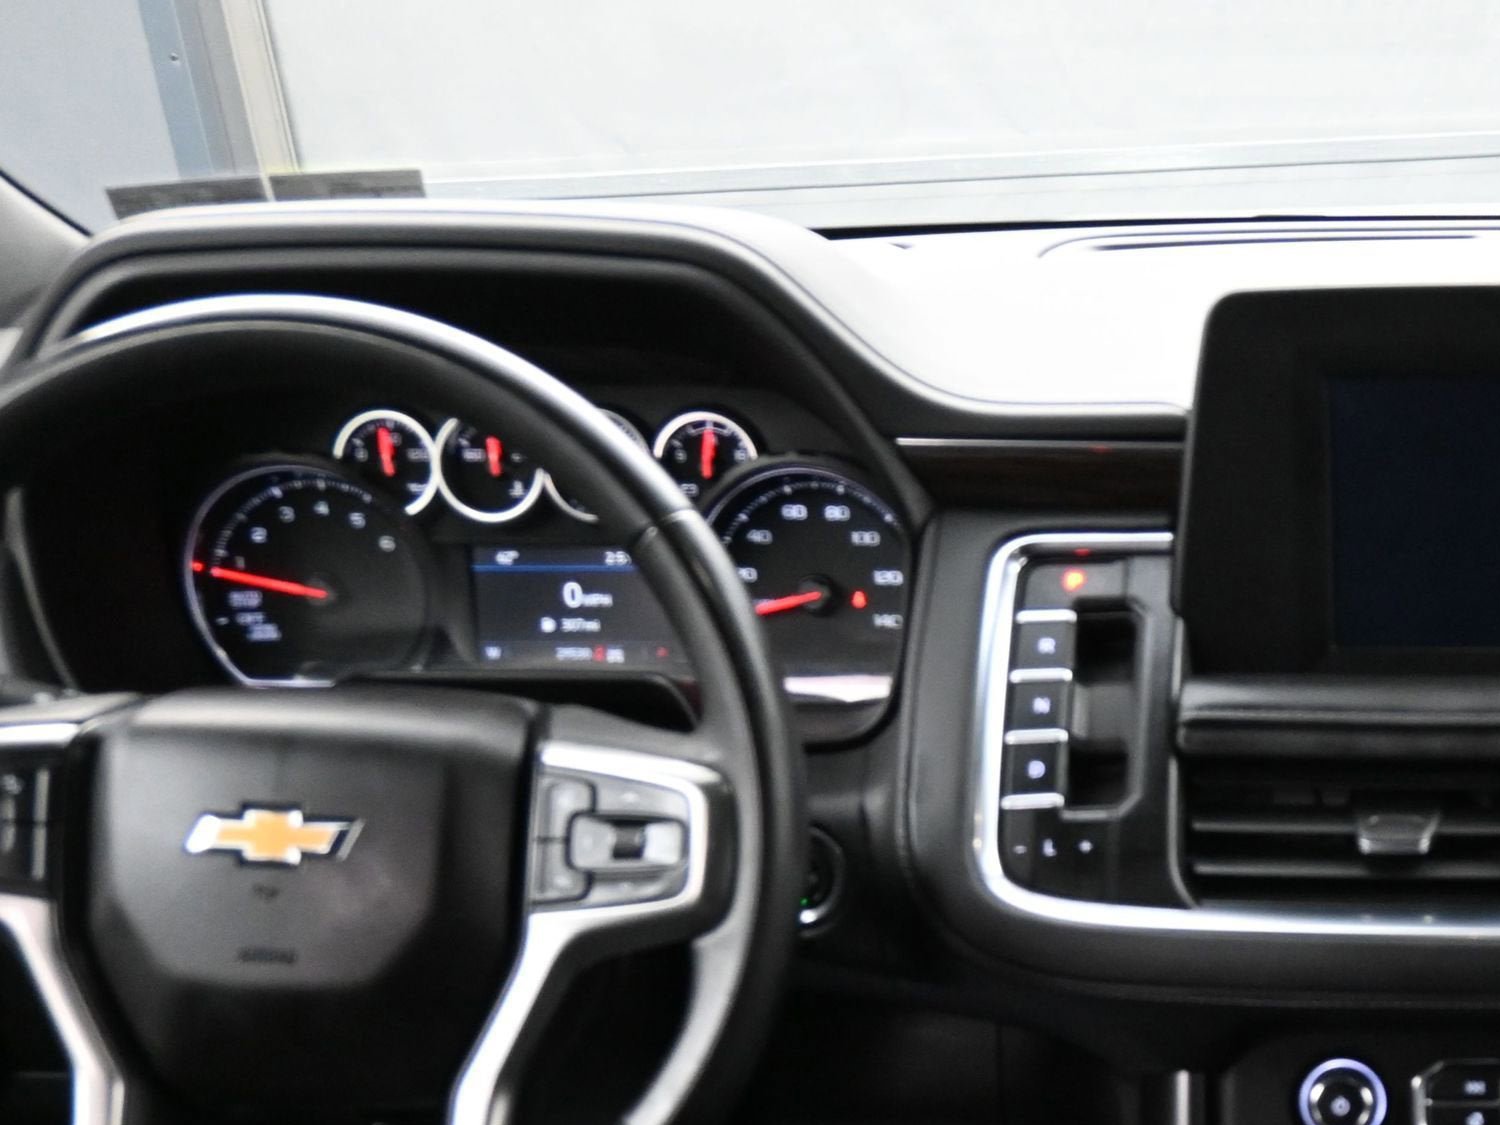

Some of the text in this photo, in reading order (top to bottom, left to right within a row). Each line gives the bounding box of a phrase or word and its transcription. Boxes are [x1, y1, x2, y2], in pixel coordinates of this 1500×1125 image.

[781, 504, 808, 520] 60
[823, 505, 850, 521] 80
[349, 512, 367, 529] 5
[747, 530, 773, 545] 40
[850, 531, 881, 546] 100
[562, 581, 583, 608] 0
